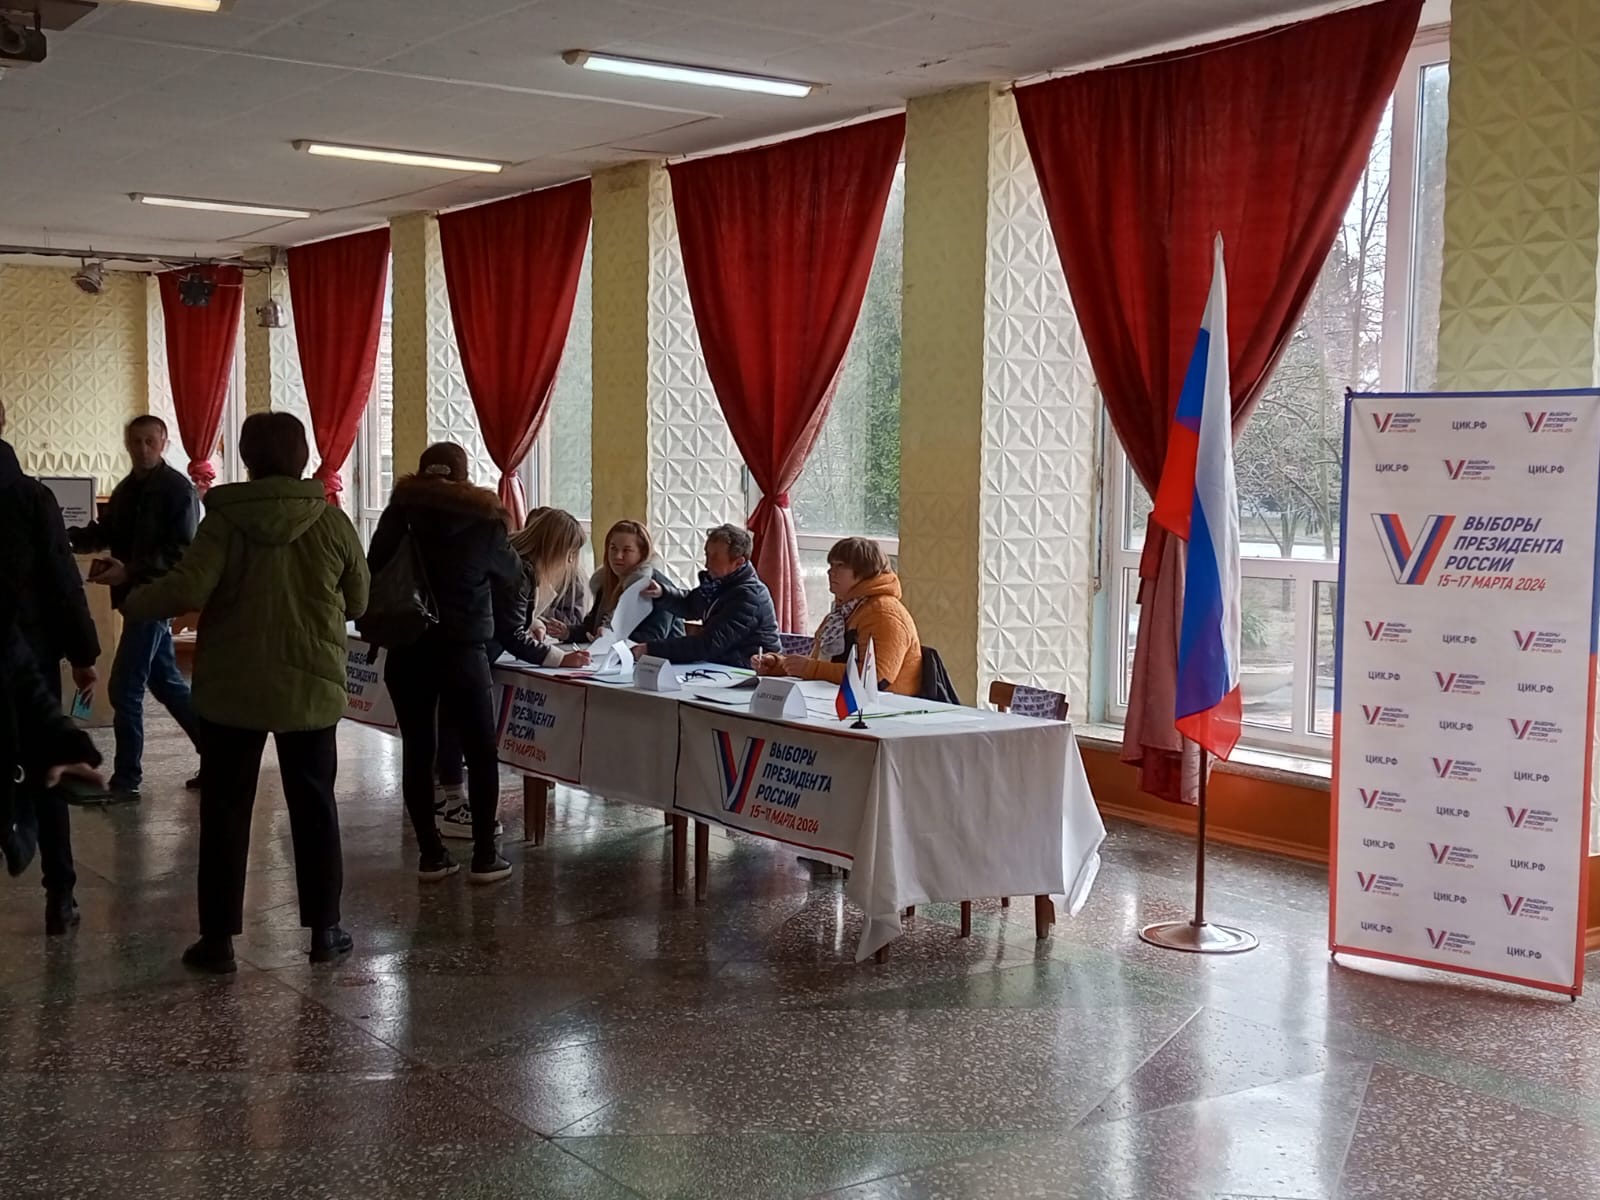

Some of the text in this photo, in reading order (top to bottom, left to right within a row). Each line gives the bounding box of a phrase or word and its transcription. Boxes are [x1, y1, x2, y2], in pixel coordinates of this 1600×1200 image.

[1451, 420, 1488, 432] ЦИК.РФ
[1375, 463, 1410, 474] ЦИК.РФ
[1527, 464, 1565, 476] ЦИК.РФ
[1463, 516, 1542, 533] ВЫБОРЫ
[1453, 536, 1564, 554] ПРЕЗИДЕНТА
[1444, 556, 1514, 572] РОССИИ
[1471, 575, 1514, 590] МАРТА
[1515, 577, 1546, 592] 2024
[1442, 633, 1478, 645] ЦИК.РФ
[1367, 670, 1401, 682] ЦИК.РФ
[1517, 682, 1555, 694] ЦИК.РФ
[1438, 719, 1474, 732] ЦИК.РФ
[769, 741, 818, 767] ВЫБОРЫ
[1364, 754, 1399, 766] ЦИК.РФ
[762, 762, 832, 793] ПРЕЗИДЕНТА
[1513, 770, 1551, 783] ЦИК.РФ
[755, 784, 801, 809] РОССИИ
[1435, 805, 1471, 819] ЦИК.РФ
[770, 808, 796, 830] МАРТА
[795, 817, 819, 834] 2024
[1362, 837, 1396, 850] ЦИК.РФ
[1509, 858, 1546, 872] ЦИК.РФ
[1432, 891, 1468, 905] ЦИК.РФ
[1360, 921, 1393, 934] ЦИК.РФ
[1506, 945, 1543, 960] ЦИК.РФ
